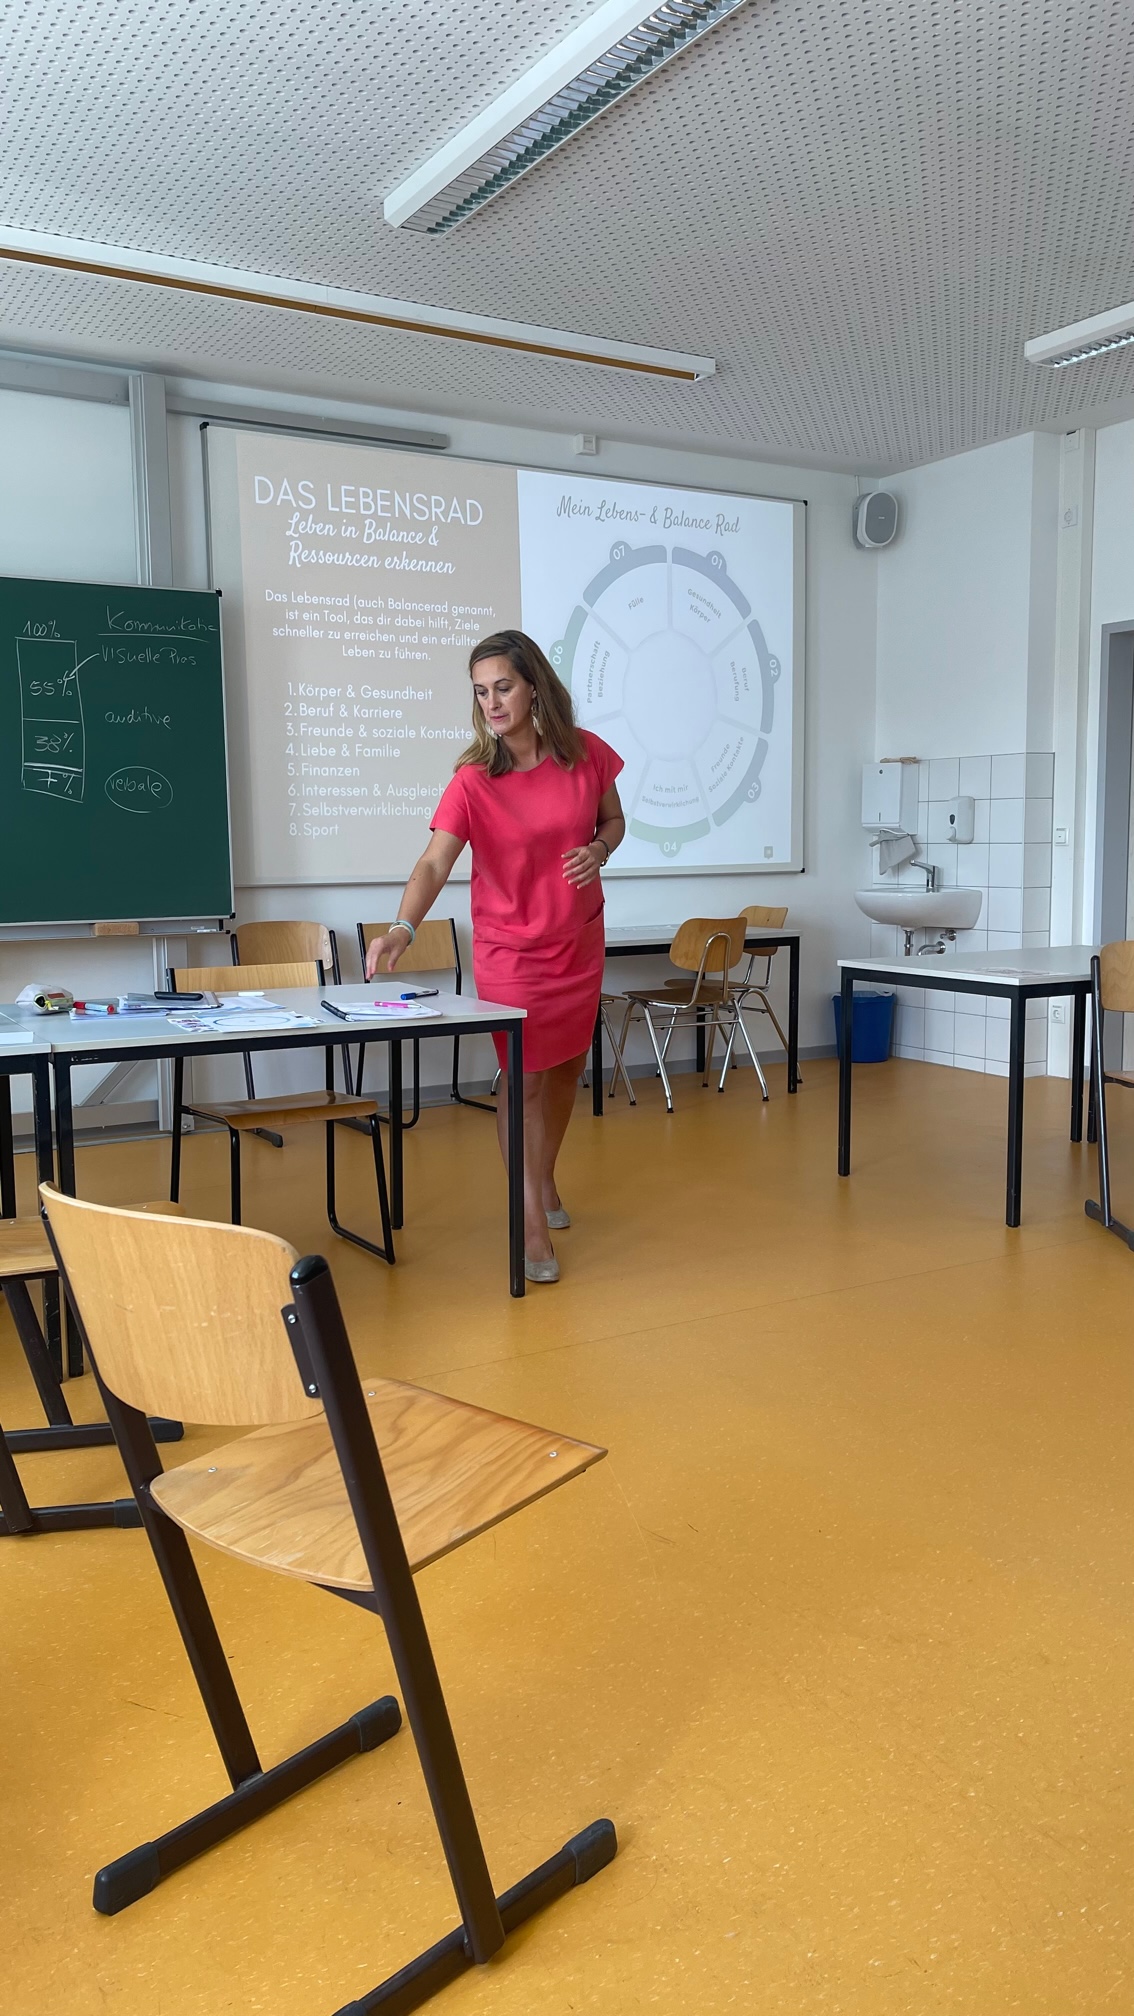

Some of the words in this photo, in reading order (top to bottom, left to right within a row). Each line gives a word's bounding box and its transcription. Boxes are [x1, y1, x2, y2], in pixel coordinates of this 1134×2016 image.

[254, 475, 316, 509] DAS
[327, 483, 483, 526] LEBENSRAD
[556, 495, 593, 518] Mein
[594, 499, 646, 522] Lebens-
[649, 505, 658, 525] &
[663, 506, 712, 530] Balance
[714, 513, 741, 537] Rad
[285, 511, 337, 538] Leben
[341, 518, 359, 538] in
[363, 518, 426, 544] Balance
[428, 525, 439, 547] &
[288, 540, 381, 568] Ressourcen
[384, 551, 456, 575] erkennen
[612, 545, 626, 560] 07
[711, 555, 723, 570] 01
[265, 589, 288, 602] Das
[291, 590, 350, 607] Lebensrad
[353, 594, 385, 610] (auch
[388, 597, 448, 614] Balancerad
[451, 605, 496, 618] genannt,
[627, 597, 644, 610] Fülle
[687, 588, 722, 619] Gesundheit
[689, 604, 711, 623] Körper
[22, 619, 61, 638] 100%
[285, 608, 299, 620] ist
[302, 610, 320, 622] ein
[323, 610, 350, 625] Tool,
[353, 611, 374, 625] das
[376, 613, 391, 626] dir
[394, 614, 425, 628] dabei
[428, 616, 452, 631] hilft,
[455, 618, 480, 631] Ziele
[272, 624, 324, 639] schneller
[328, 630, 341, 640] zu
[344, 629, 396, 643] erreichen
[399, 631, 418, 644] und
[422, 633, 438, 645] ein
[342, 644, 376, 658] Leben
[379, 649, 391, 659] zu
[394, 646, 431, 661] führen.
[552, 645, 563, 665] 06
[586, 640, 601, 704] Partnerschaft
[597, 650, 611, 698] Beziehung
[769, 659, 779, 678] 02
[29, 670, 74, 697] 55%
[729, 661, 740, 702] Berufung
[741, 667, 750, 692] Beruf
[346, 684, 356, 698] &
[360, 685, 433, 700] Gesundheit
[104, 706, 172, 730] auditive
[339, 703, 349, 718] &
[353, 704, 403, 719] Karriere
[34, 732, 75, 753] 38%
[358, 724, 367, 738] &
[372, 724, 416, 739] soziale
[420, 725, 473, 740] Kontakte
[341, 743, 350, 757] &
[355, 743, 401, 758] Familie
[710, 743, 731, 773] Freunde
[708, 771, 728, 793] Soziale
[726, 736, 744, 772] Kontakte
[33, 768, 75, 795] 7%
[109, 775, 163, 799] verbale
[372, 783, 382, 797] &
[386, 783, 445, 801] Ausgleich
[653, 783, 664, 793] Ich
[664, 785, 676, 794] mit
[677, 783, 688, 793] mir
[747, 782, 760, 799] 03
[641, 795, 700, 808] Selbstverwirklichung
[663, 841, 678, 853] 04
